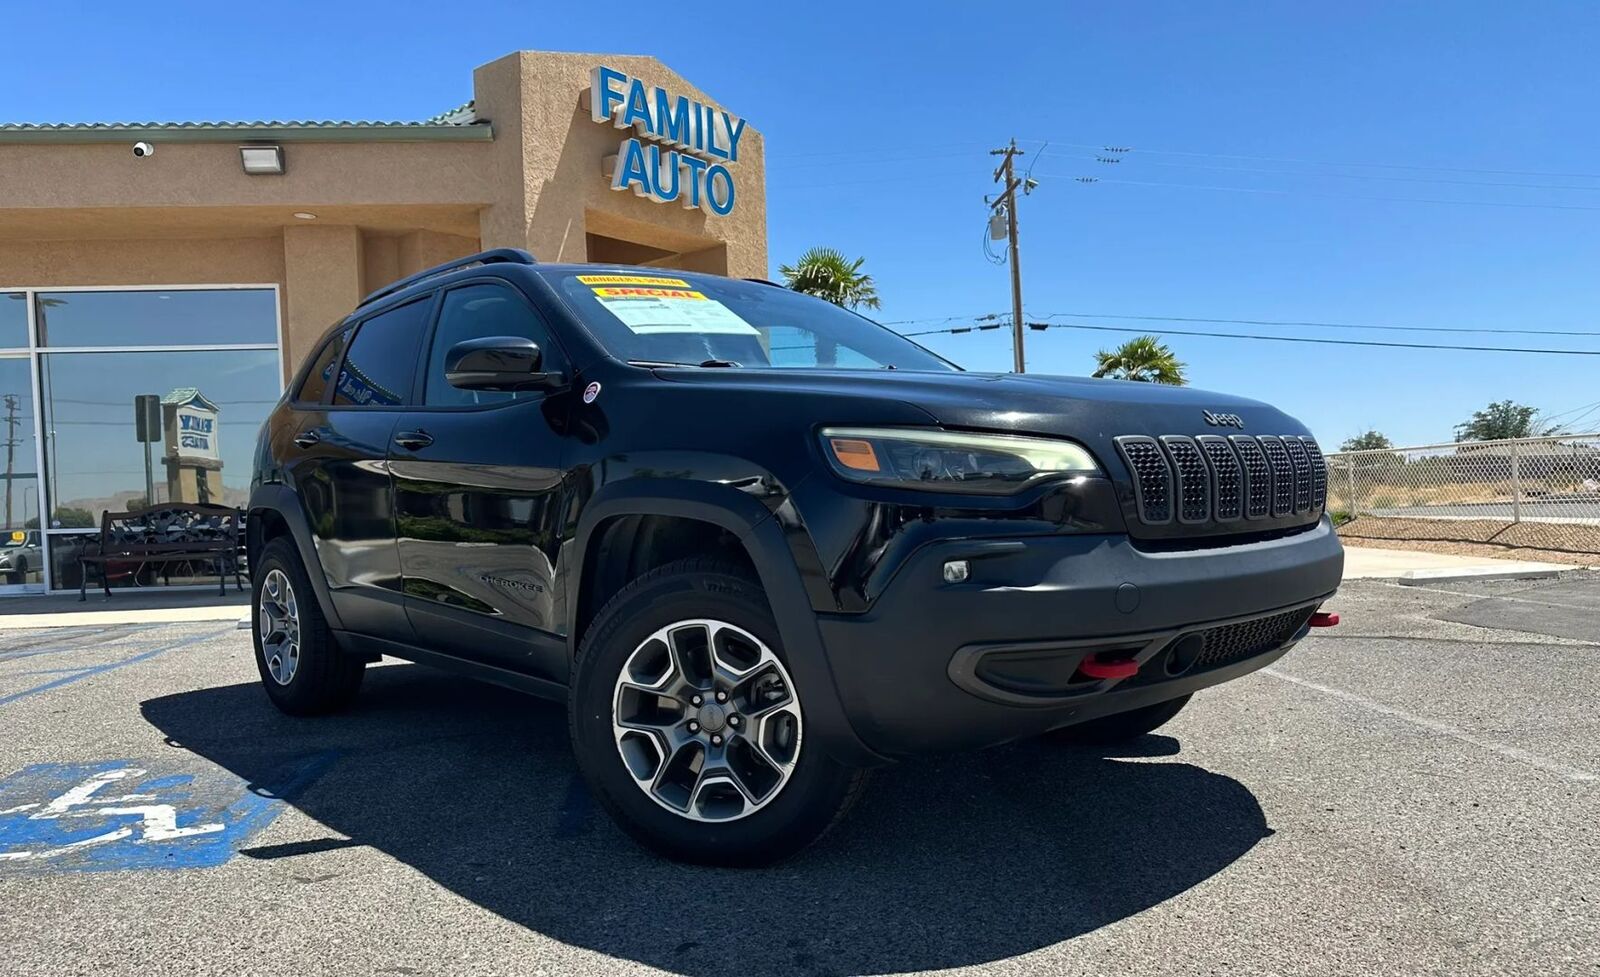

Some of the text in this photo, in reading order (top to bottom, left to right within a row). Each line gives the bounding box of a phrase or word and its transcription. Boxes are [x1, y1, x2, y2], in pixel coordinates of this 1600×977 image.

[598, 65, 746, 162] FAMILY
[617, 138, 735, 217] AUTO
[604, 287, 699, 299] SPECIAL
[1202, 409, 1244, 430] Jeep
[480, 575, 544, 593] CHEROKEE
